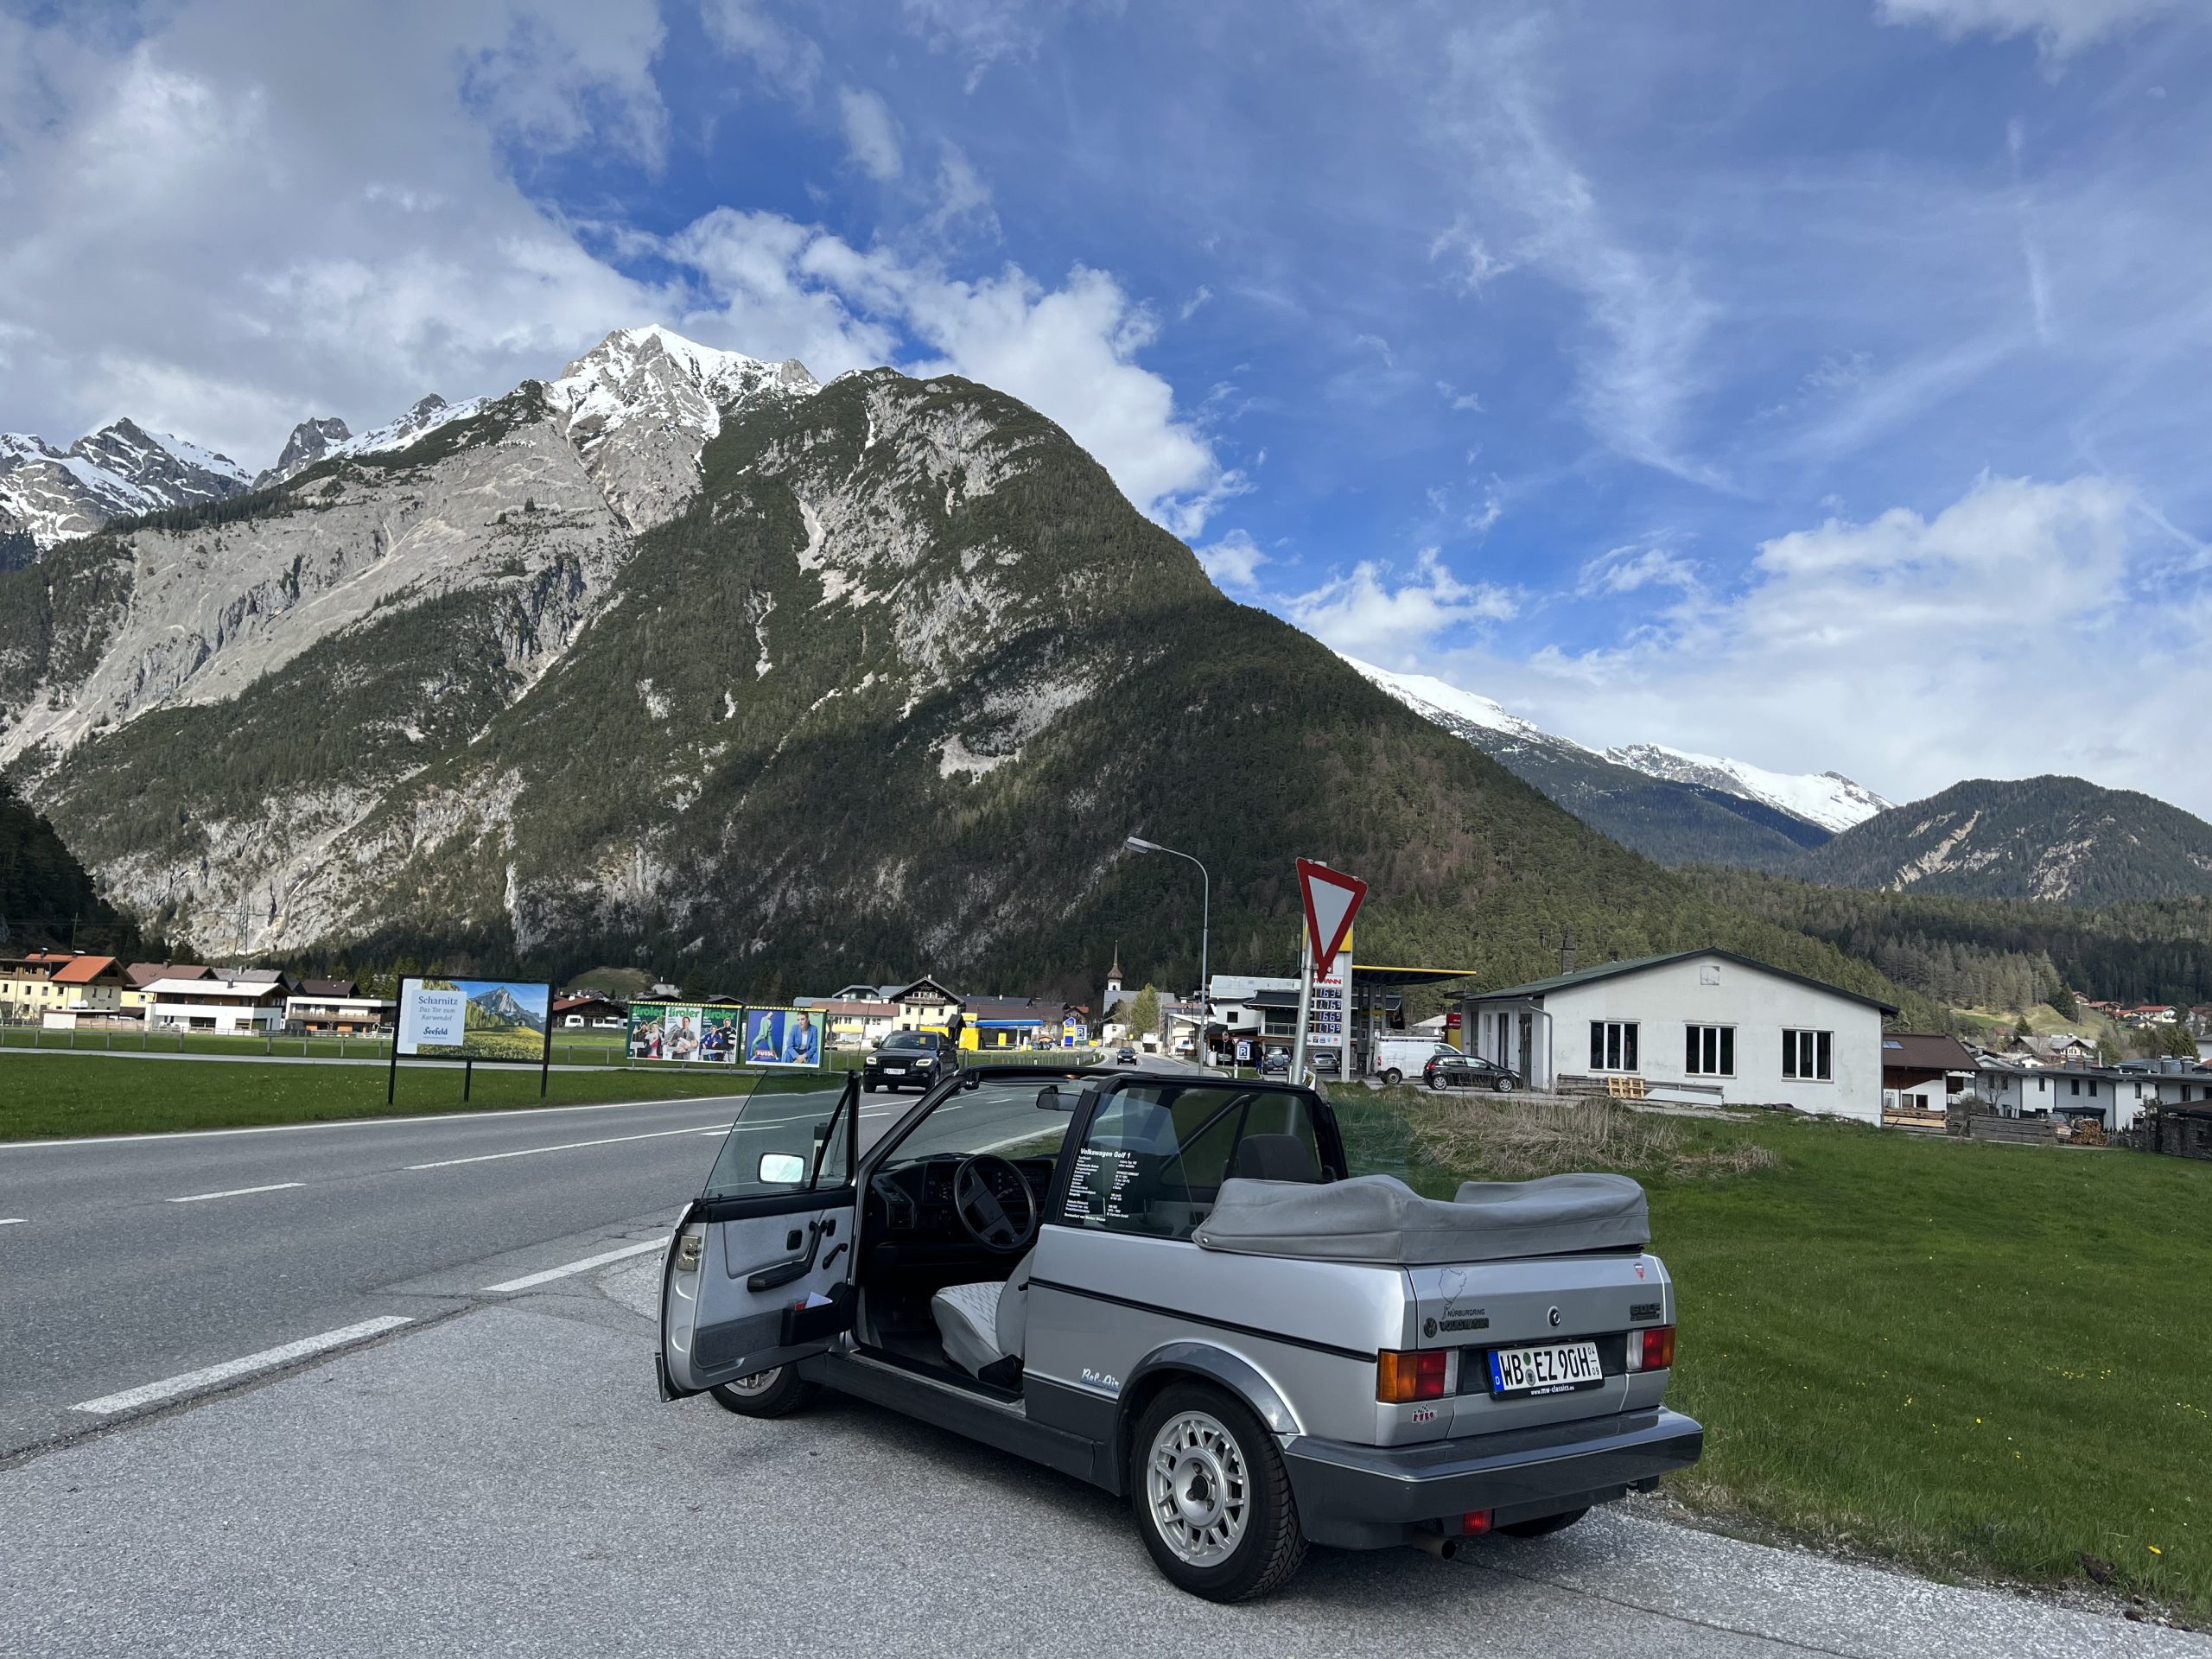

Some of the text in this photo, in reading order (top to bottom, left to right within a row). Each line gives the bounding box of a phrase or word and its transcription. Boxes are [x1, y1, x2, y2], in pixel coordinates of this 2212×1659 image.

[418, 995, 458, 1005] Scharnitz
[423, 1027, 448, 1035] Seefeld
[1081, 1148, 1113, 1158] Volkswagen
[1447, 1308, 1485, 1318] NÜRBURGRING
[1530, 1384, 1575, 1395] www.mw-classics.eu
